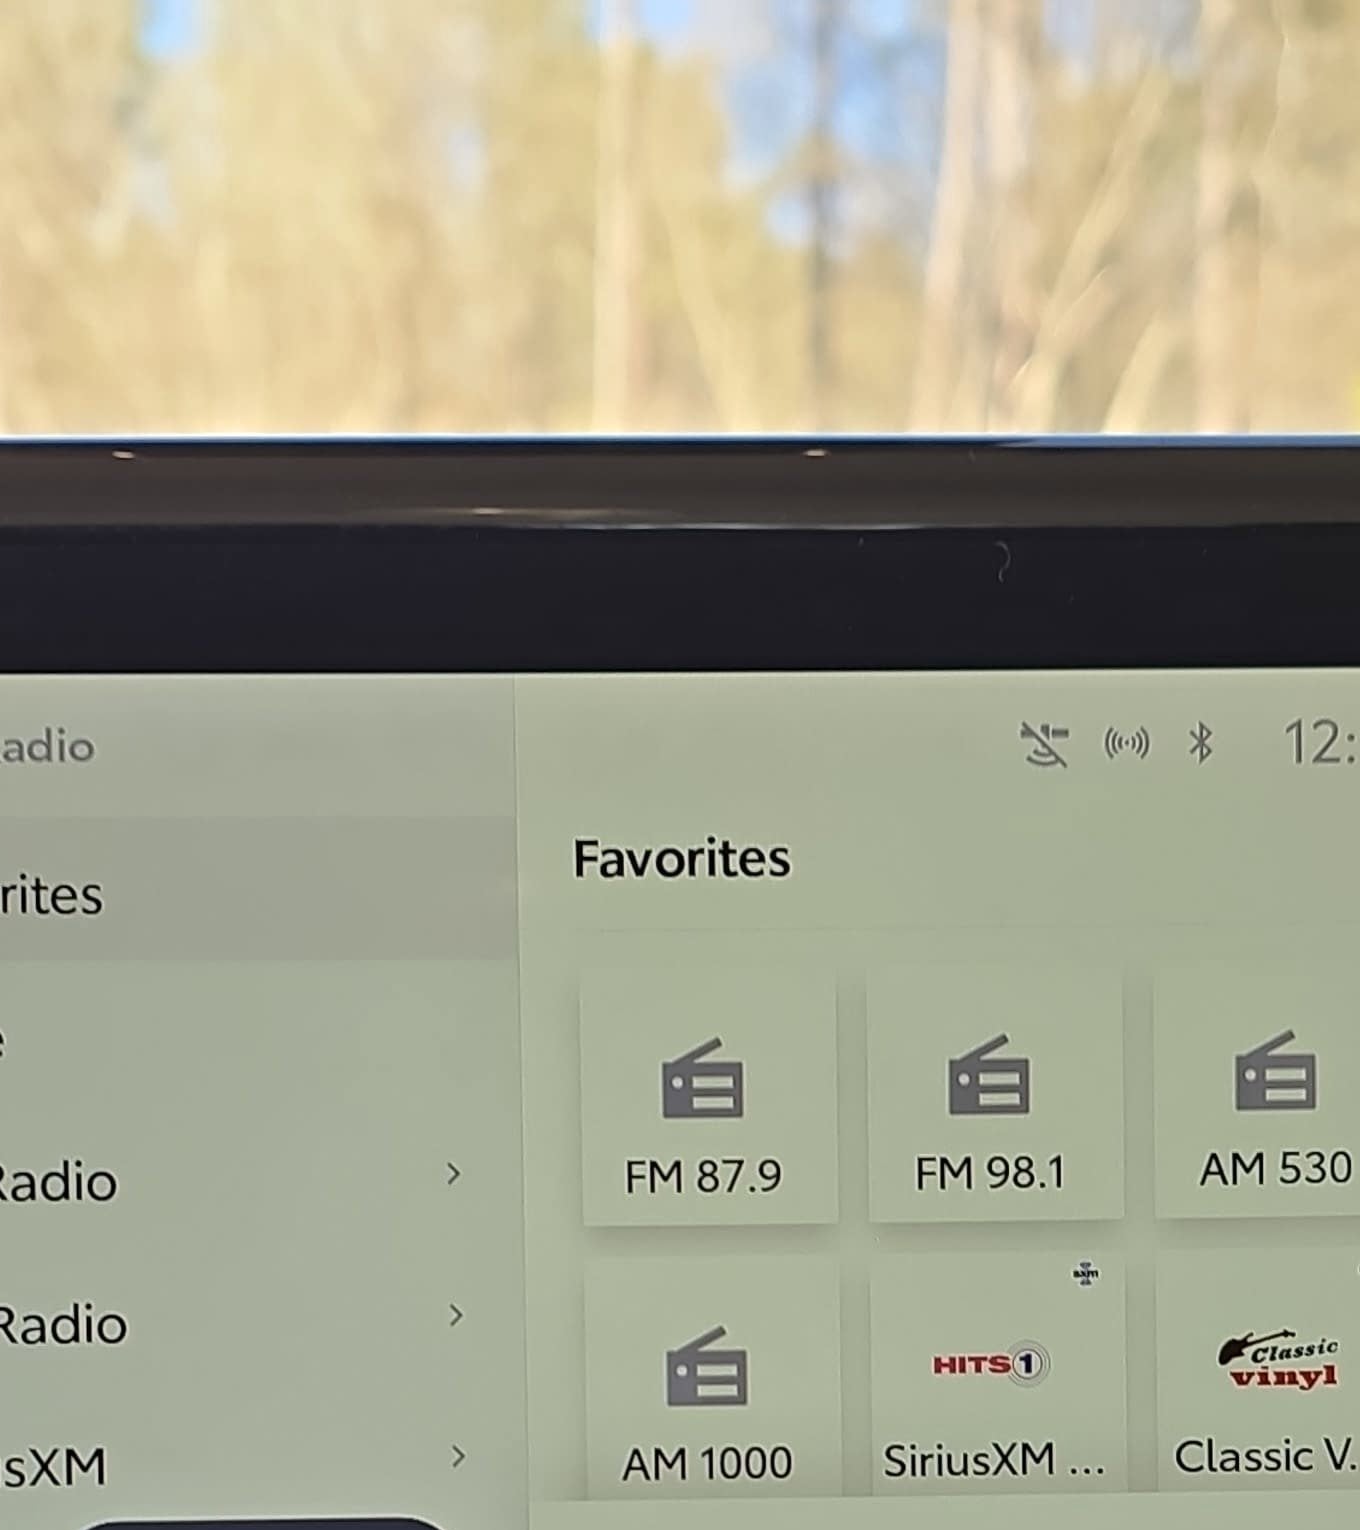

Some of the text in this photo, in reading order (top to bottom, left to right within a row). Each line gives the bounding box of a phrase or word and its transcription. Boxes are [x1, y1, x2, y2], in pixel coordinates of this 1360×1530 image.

[576, 835, 792, 879] Favorites
[626, 1158, 782, 1195] FM 87.9
[916, 1153, 1064, 1192] FM 98.1
[1198, 1149, 1353, 1187] AM 530
[933, 1354, 1012, 1374] HITS
[1251, 1337, 1339, 1363] Classic
[1229, 1364, 1338, 1391] vinyl
[621, 1445, 793, 1483] AM 1000
[883, 1441, 1055, 1478] SiriusXM
[1174, 1436, 1315, 1474] Classic
